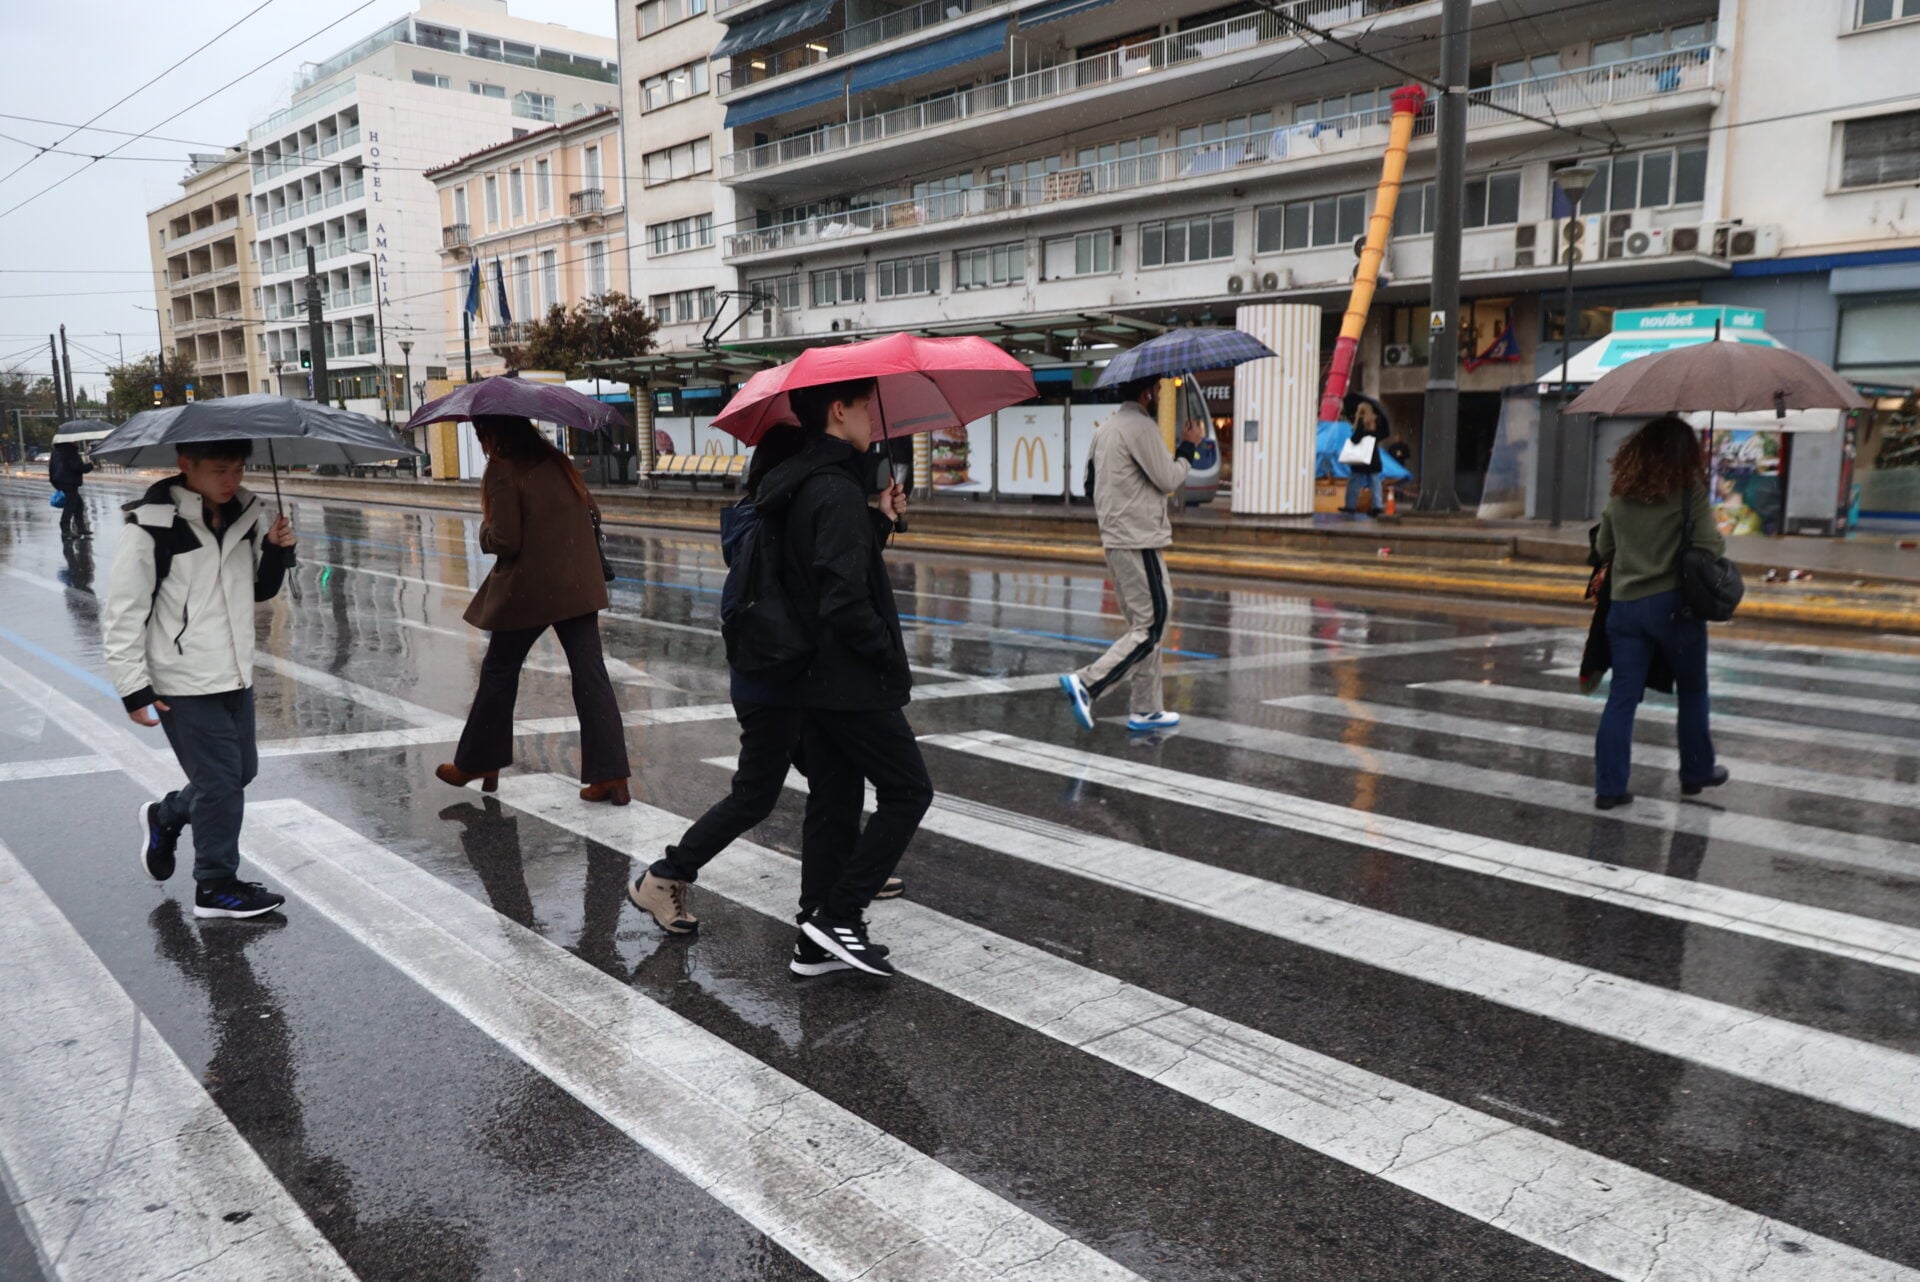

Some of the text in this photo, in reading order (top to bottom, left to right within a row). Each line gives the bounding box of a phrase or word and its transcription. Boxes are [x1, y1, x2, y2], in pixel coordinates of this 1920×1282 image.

[369, 131, 391, 306] HOTEL AMALIA
[1639, 312, 1695, 328] novibet
[1201, 385, 1231, 400] FFEE
